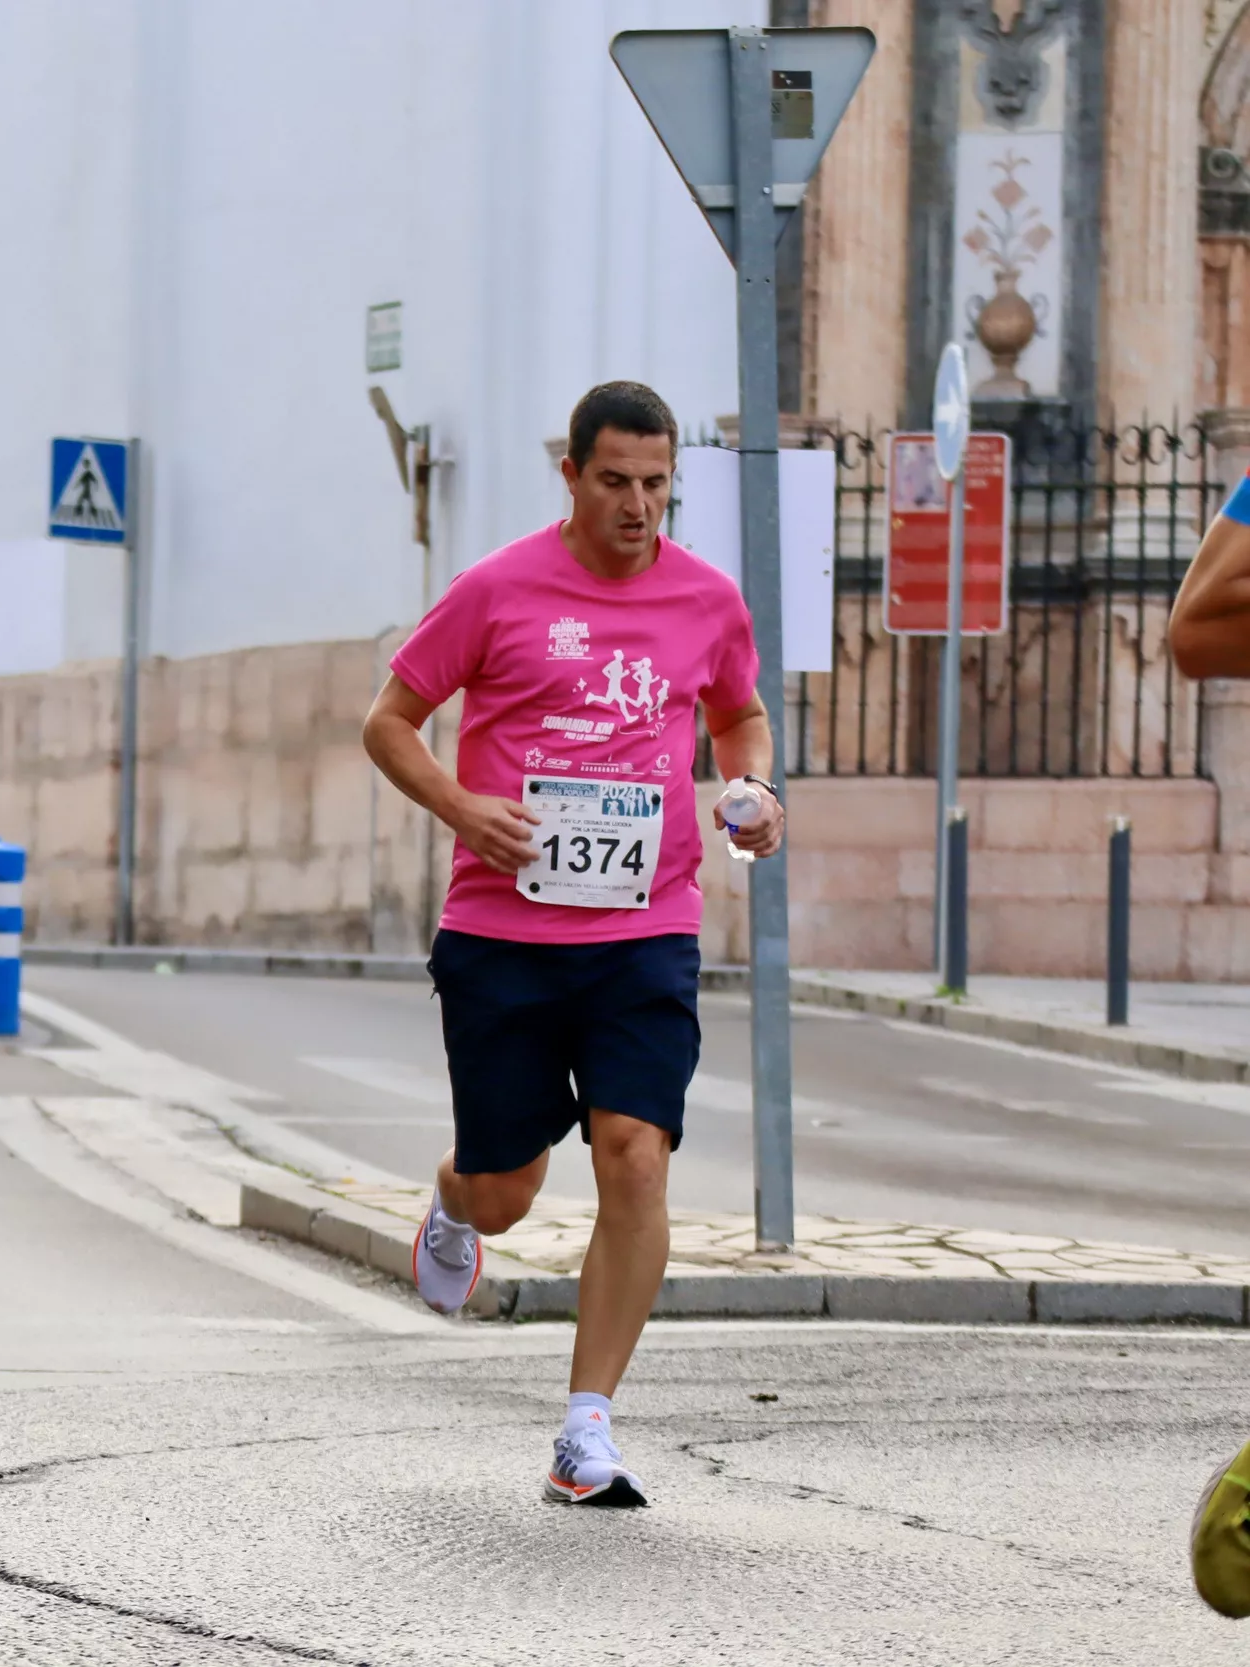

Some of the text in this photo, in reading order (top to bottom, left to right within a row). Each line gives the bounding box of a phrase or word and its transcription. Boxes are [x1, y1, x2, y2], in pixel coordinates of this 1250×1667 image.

[548, 644, 590, 652] LUCENA
[542, 715, 615, 735] SUMANDO KM
[602, 784, 636, 800] 2024
[543, 835, 644, 876] 1374
